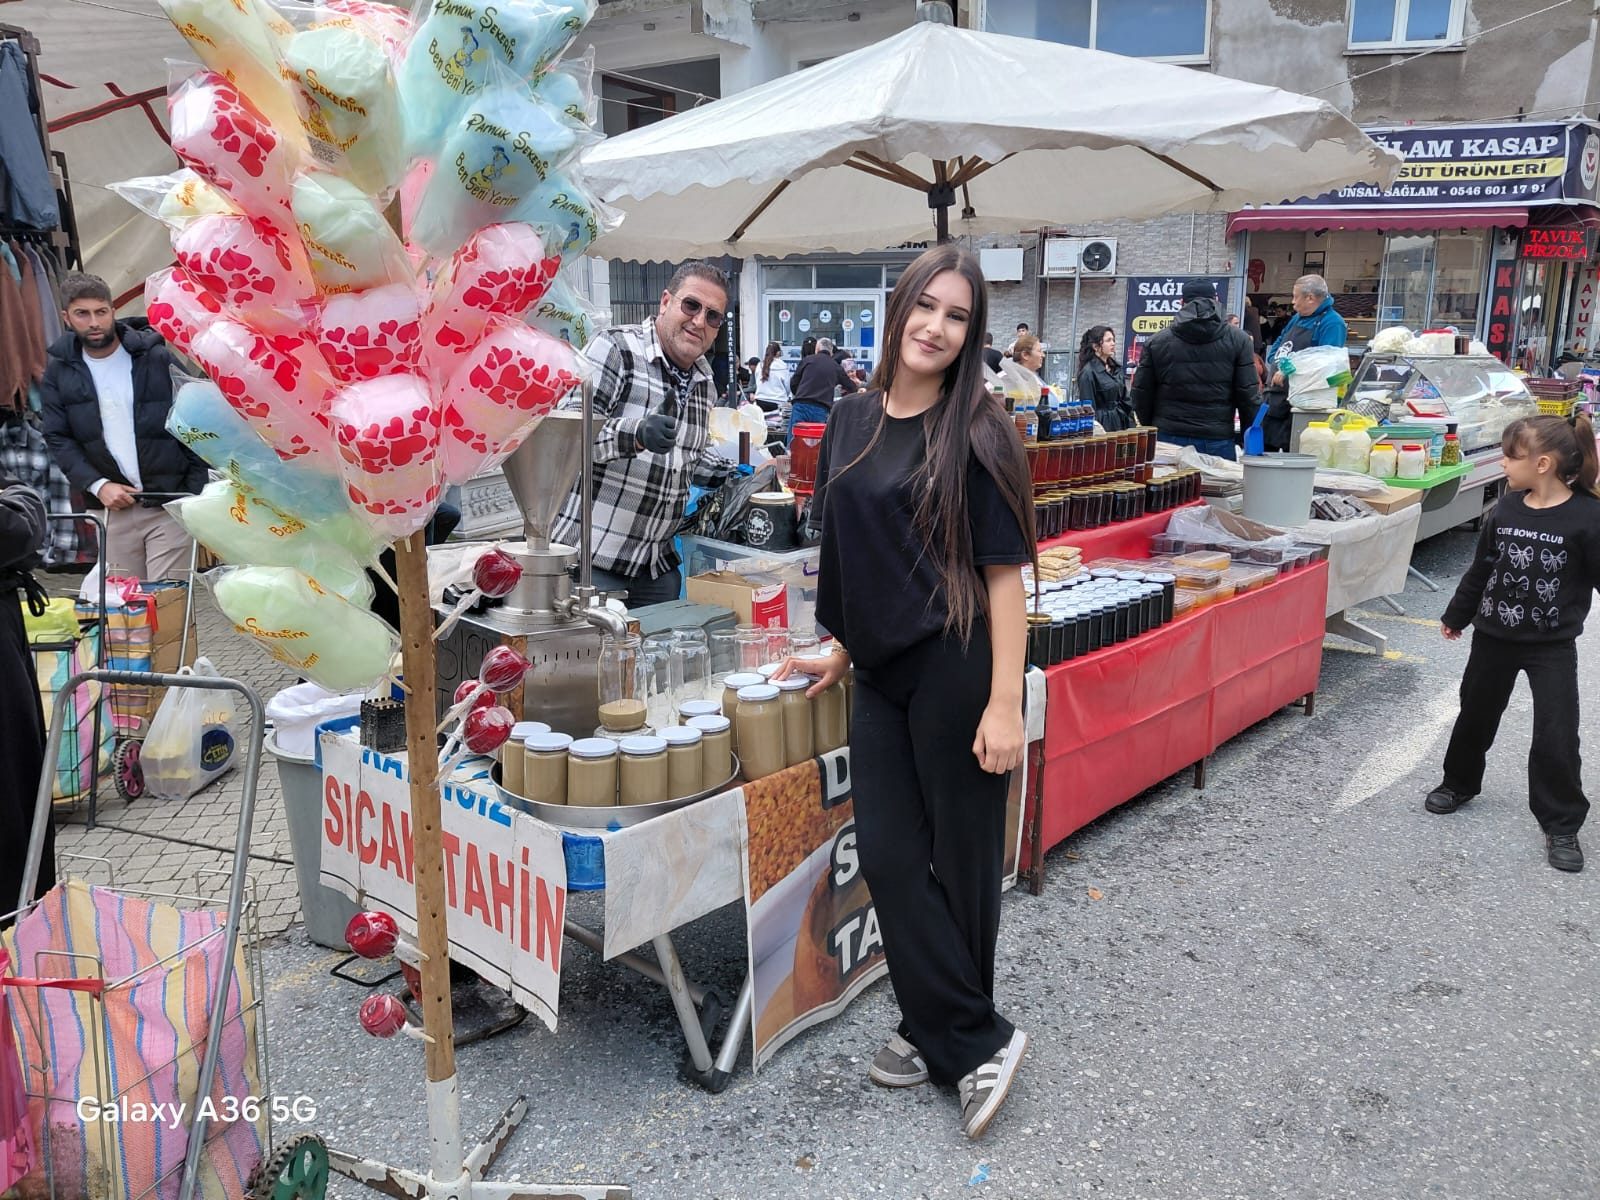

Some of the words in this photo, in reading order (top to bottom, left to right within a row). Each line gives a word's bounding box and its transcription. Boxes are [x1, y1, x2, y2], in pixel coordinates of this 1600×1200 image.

[1461, 136, 1558, 158] KASAP
[1398, 163, 1435, 178] SÜT
[1440, 161, 1547, 178] ÜRÜNLERİ
[1450, 186, 1481, 196] 0546
[1485, 186, 1507, 196] 601
[1512, 185, 1526, 195] 17
[1531, 183, 1546, 193] 91
[1529, 230, 1584, 244] TAVUK
[1575, 268, 1595, 337] TAVUK
[1496, 527, 1513, 536] CUTE
[1513, 528, 1538, 540] BOWS
[1539, 533, 1564, 544] CLUB
[442, 830, 566, 976] TAHİN
